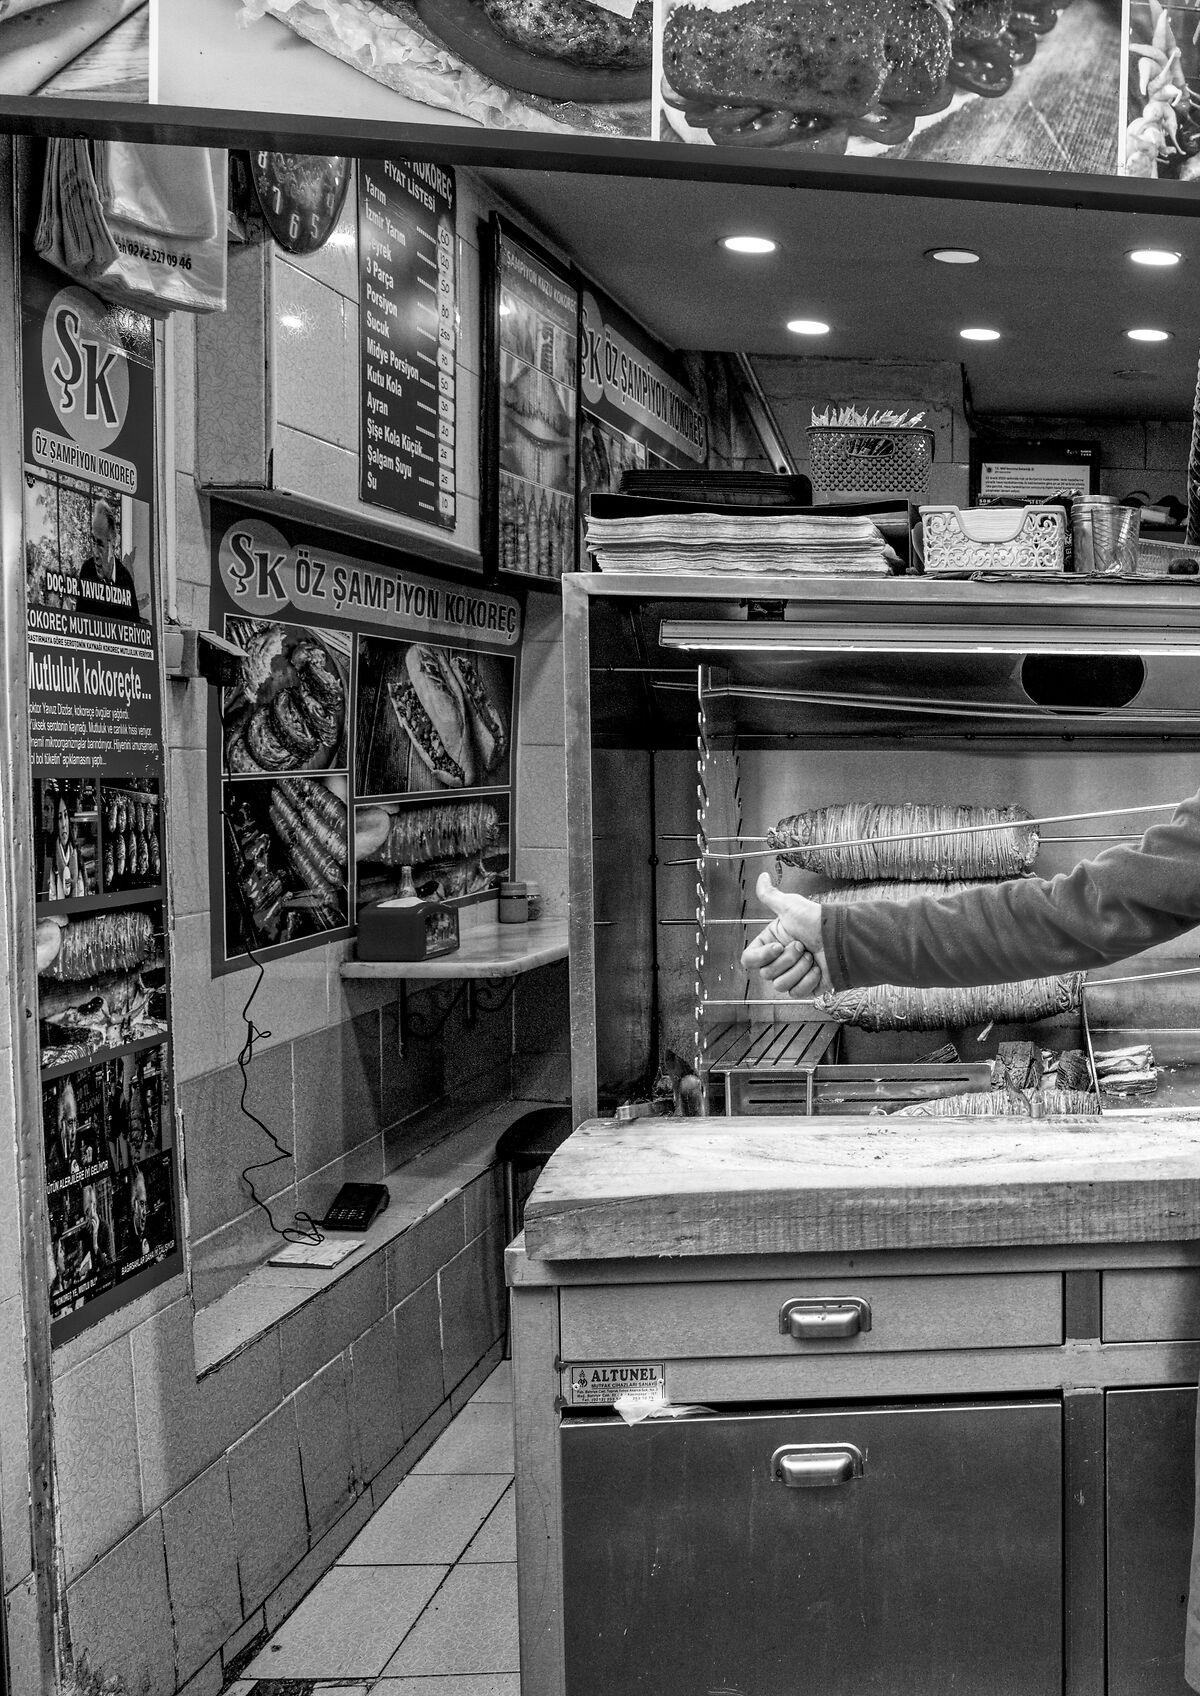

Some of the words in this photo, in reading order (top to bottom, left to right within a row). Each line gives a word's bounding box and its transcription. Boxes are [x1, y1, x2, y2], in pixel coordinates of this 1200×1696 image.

[365, 175, 386, 206] Yarım
[384, 160, 406, 188] FİYAT
[408, 179, 435, 212] LİSTESİ
[290, 214, 299, 239] 6
[365, 198, 384, 229] İzmir
[386, 217, 406, 246] Yarım
[151, 250, 165, 264] 527
[167, 254, 177, 267] 09
[179, 256, 191, 270] 46
[367, 240, 392, 262] eyrek
[367, 257, 371, 273] 3
[373, 261, 394, 289] Parça
[367, 283, 398, 317] Porsiyon
[367, 311, 390, 338] Sucuk
[53, 306, 119, 426] ŞK
[367, 337, 388, 364] Midye
[390, 350, 419, 380] Porsiyon
[367, 364, 384, 387] Kutu
[386, 374, 401, 397] Kola
[605, 331, 618, 387] ÖZ
[621, 352, 668, 425] ŞAMPİYON
[367, 392, 388, 416] Ayran
[367, 418, 382, 441] Şişe
[385, 426, 400, 448] Kola
[36, 431, 47, 456] ÖZ
[50, 440, 96, 473] ŞAMPİYON
[99, 458, 135, 490] KOKOREÇ
[367, 445, 393, 470] Şalgam
[395, 457, 412, 480] Suyu
[367, 472, 377, 490] Su
[229, 532, 288, 600] ŞK
[47, 572, 66, 598] DOÇ.
[67, 576, 80, 596] DR.
[81, 579, 104, 600] YAVUZ
[106, 582, 132, 606] DİZDAR
[295, 550, 326, 598] ÖZ
[332, 566, 438, 620] ŞAMPİYON
[444, 591, 516, 640] KOKOREÇ
[70, 616, 117, 640] MUTLULUK
[118, 624, 152, 646] VERİYOR
[30, 702, 41, 714] oktor
[31, 719, 46, 730] üksek
[47, 1180, 59, 1194] ÜTÜN
[591, 1368, 656, 1382] ALTUNEL
